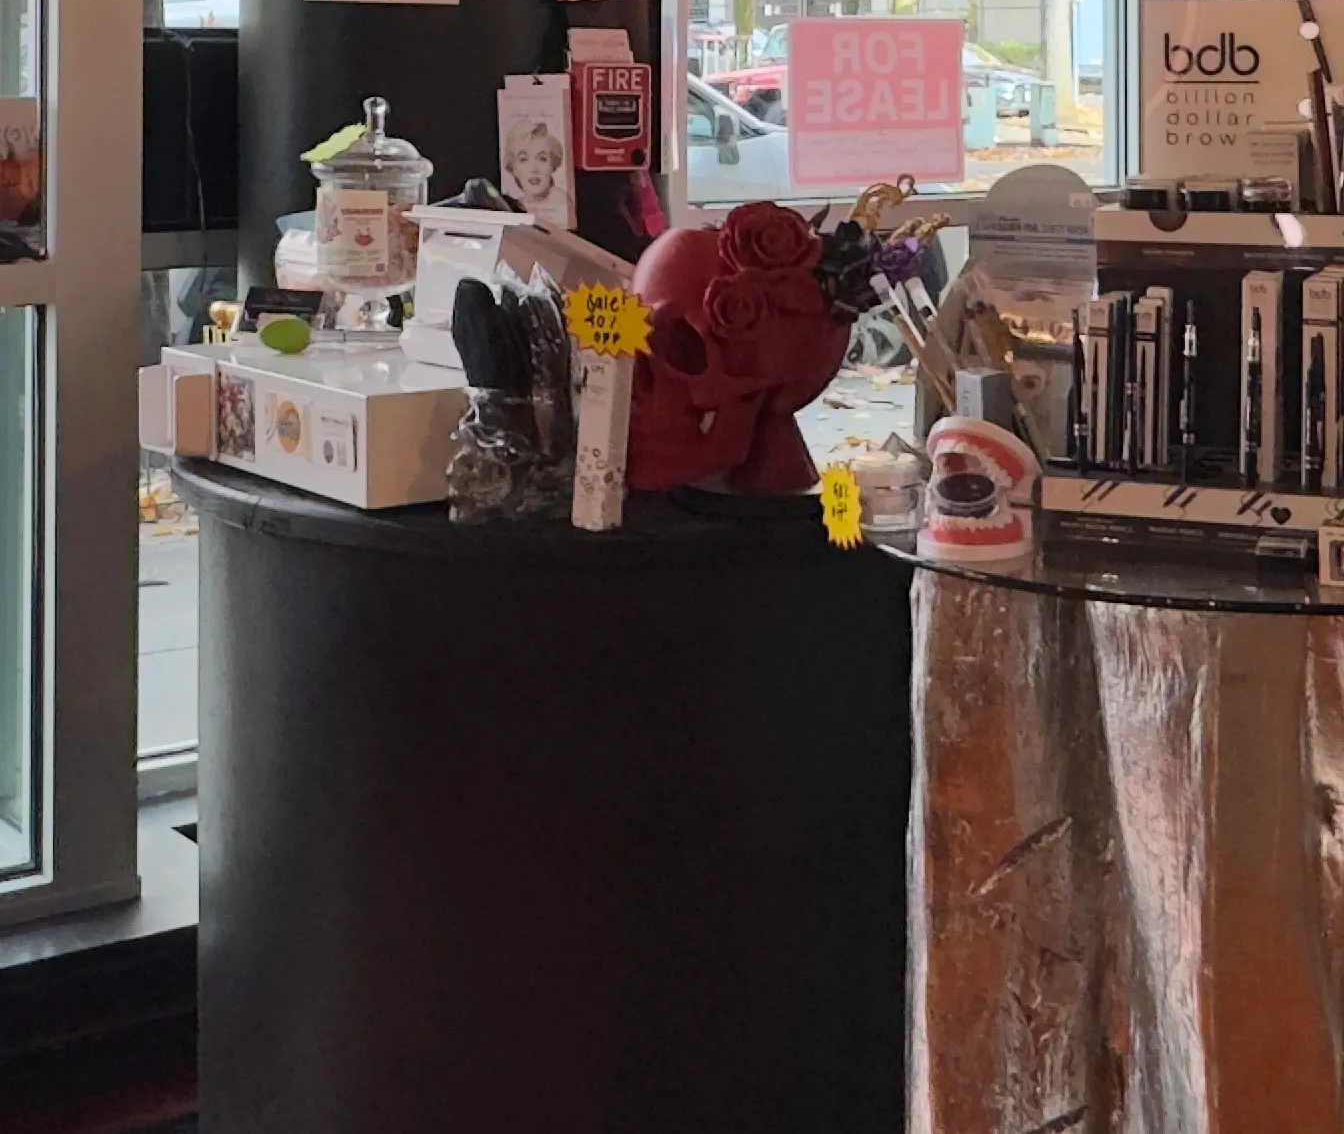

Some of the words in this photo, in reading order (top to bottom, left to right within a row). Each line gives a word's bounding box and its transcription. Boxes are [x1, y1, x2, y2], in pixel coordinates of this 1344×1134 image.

[1164, 32, 1260, 75] bdb
[592, 68, 644, 90] FIRE
[1166, 90, 1255, 104] billion
[1166, 110, 1255, 126] dollar
[1166, 130, 1237, 146] brow
[587, 293, 626, 313] Sale!
